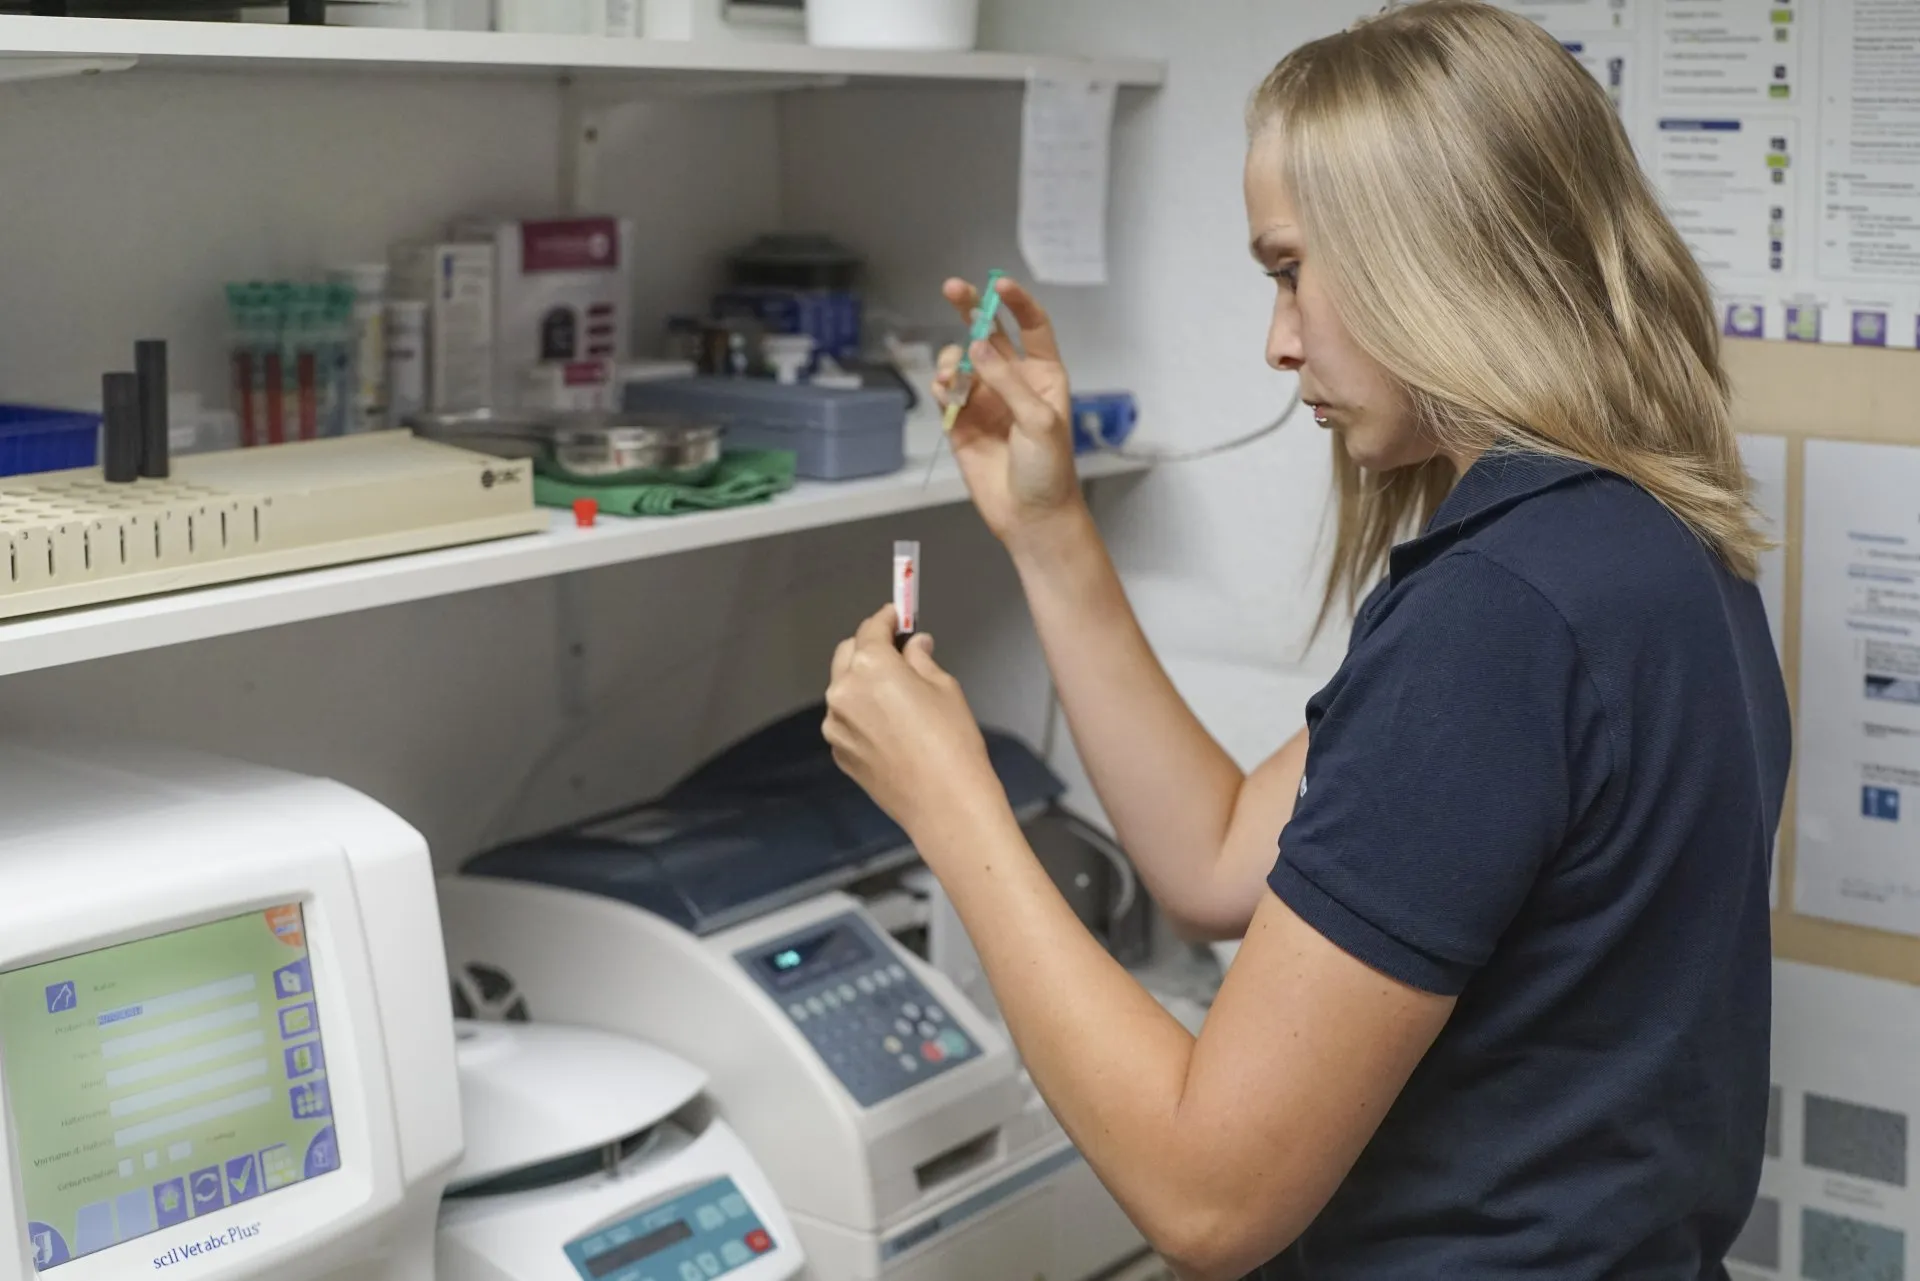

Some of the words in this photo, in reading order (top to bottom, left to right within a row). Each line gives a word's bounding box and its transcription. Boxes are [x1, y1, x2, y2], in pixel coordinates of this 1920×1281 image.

[153, 1248, 179, 1269] scil
[179, 1241, 204, 1259] Vet
[204, 1235, 228, 1252] abc
